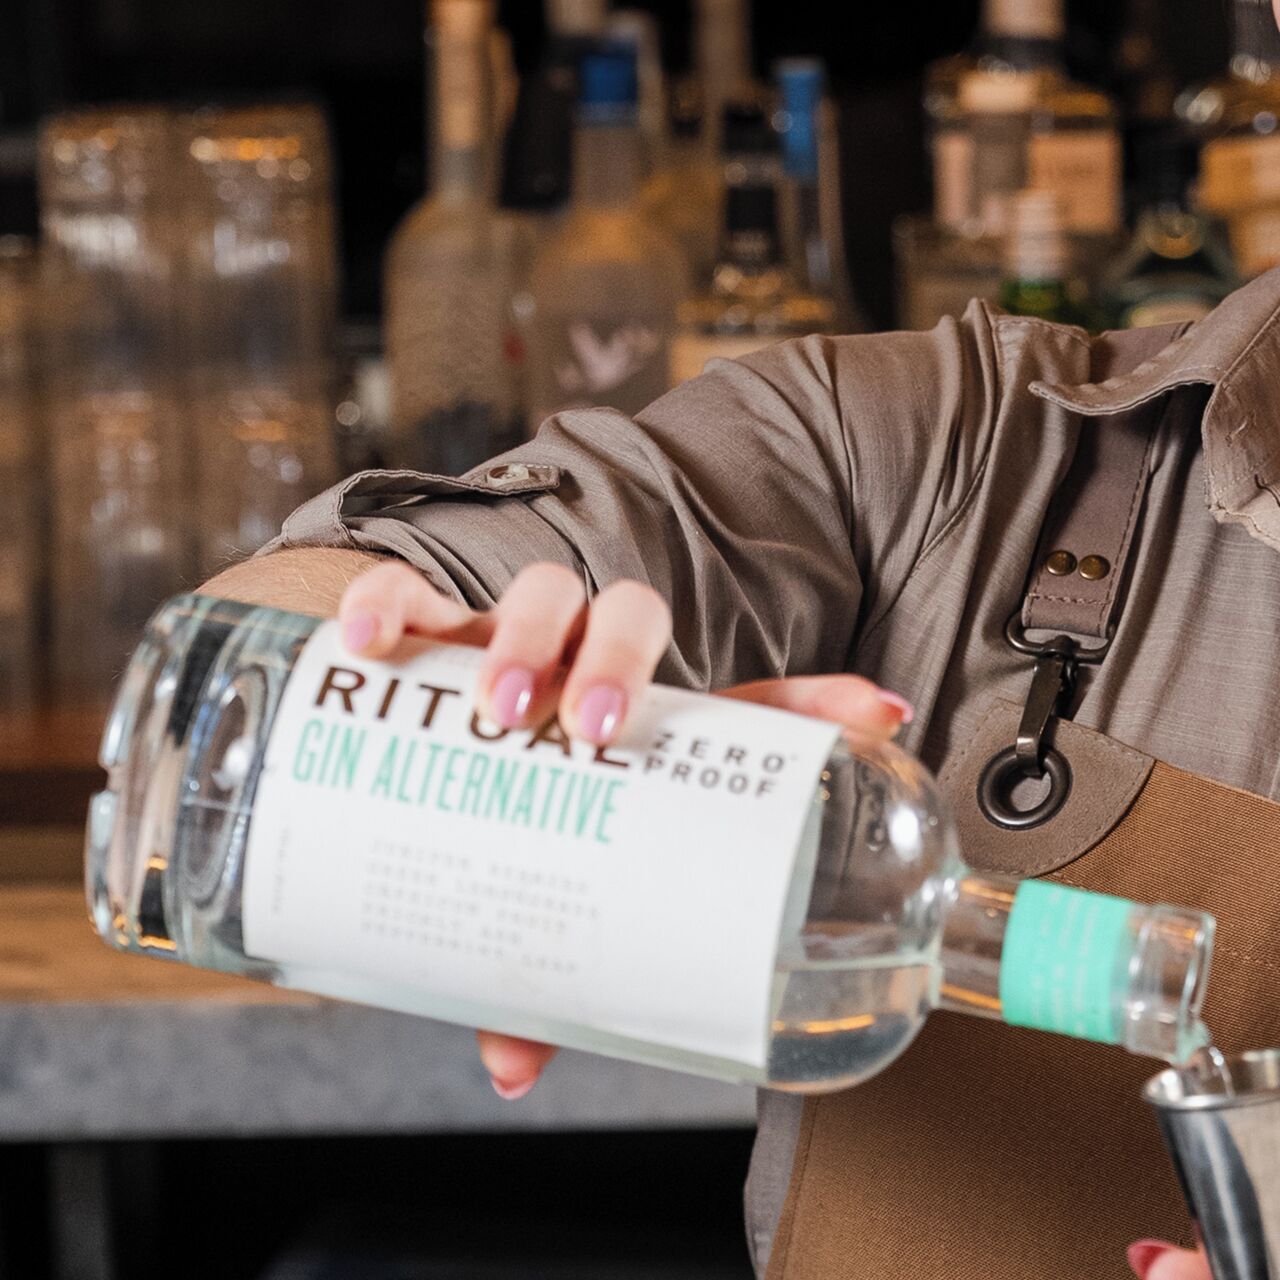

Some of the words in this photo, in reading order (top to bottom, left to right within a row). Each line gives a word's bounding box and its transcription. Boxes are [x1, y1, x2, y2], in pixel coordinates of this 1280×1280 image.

[652, 731, 785, 774] ZERO
[292, 719, 367, 789] GIN
[370, 734, 627, 844] ALTERNATIVE
[644, 756, 777, 798] PROOF
